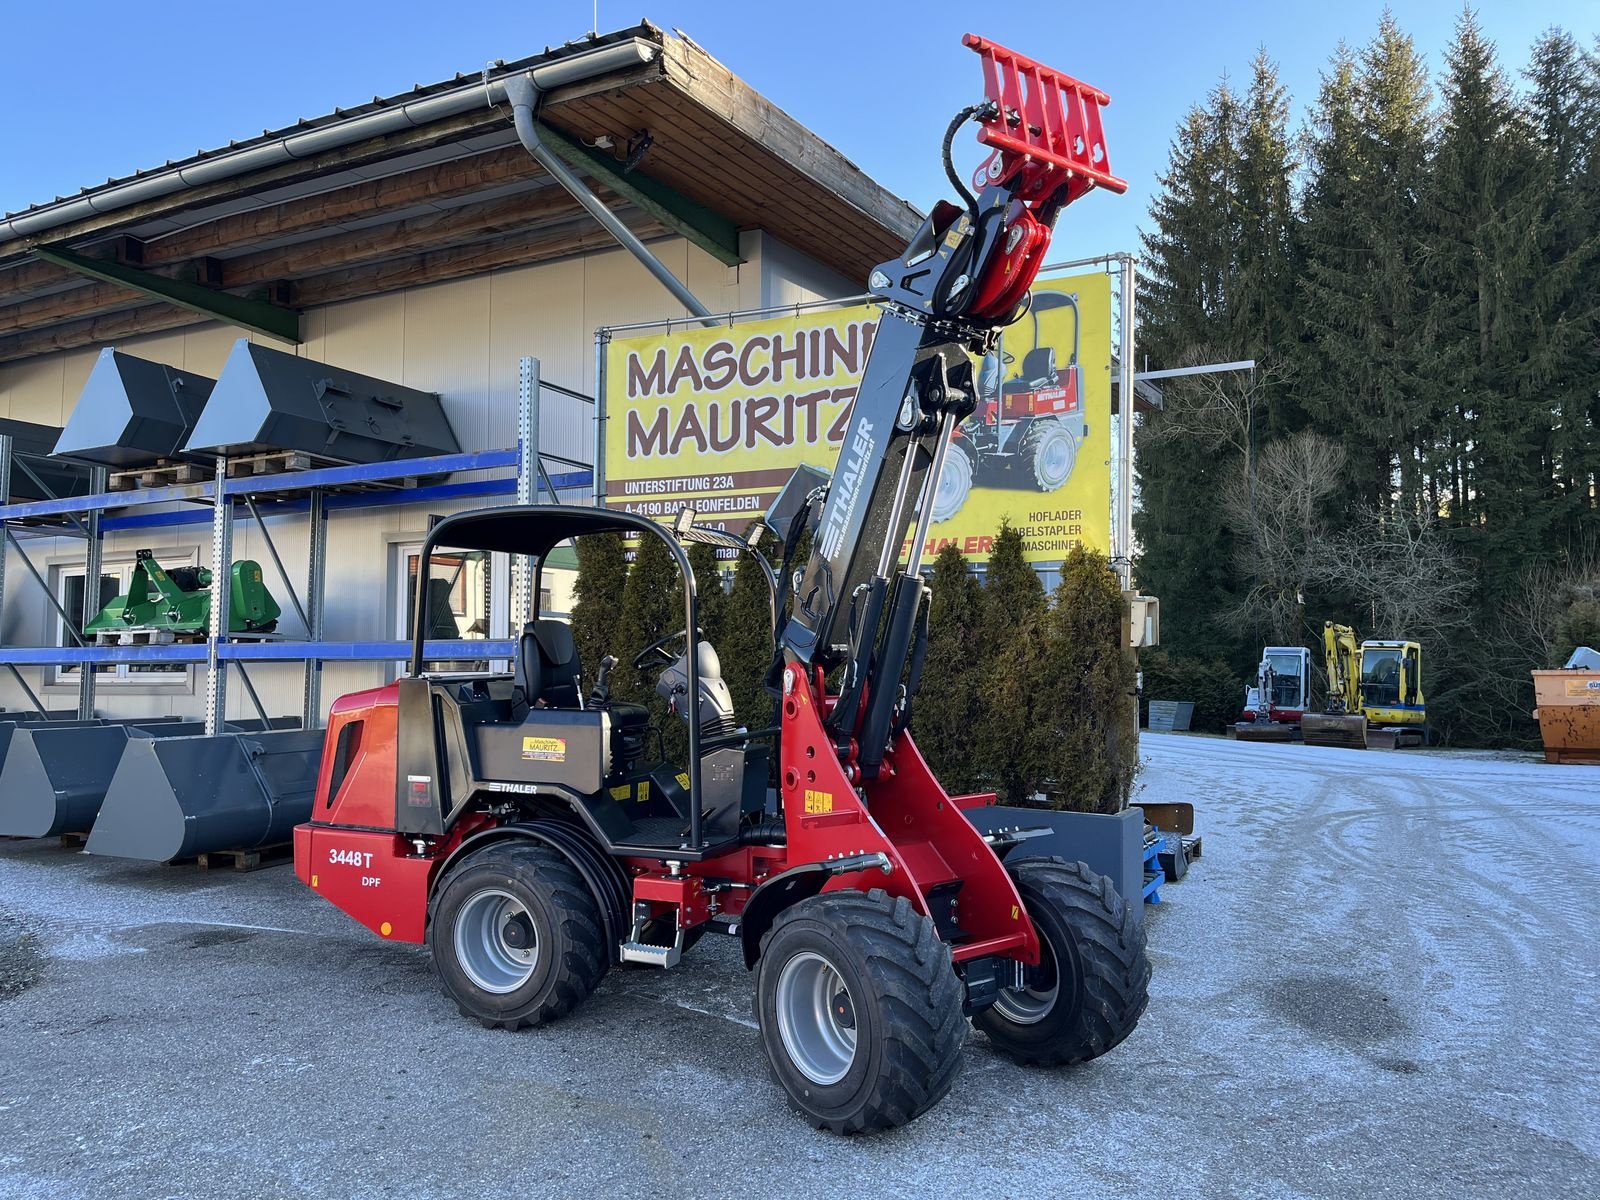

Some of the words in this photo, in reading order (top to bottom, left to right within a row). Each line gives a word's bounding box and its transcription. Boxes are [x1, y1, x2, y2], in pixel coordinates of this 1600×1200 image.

[625, 478, 710, 495] UNTERSTIFTUNG
[713, 475, 735, 489] 23A
[834, 438, 876, 559] www.maschinen-mauritz.at
[625, 503, 662, 515] A-4190
[1029, 510, 1082, 522] HOFLADER
[361, 876, 381, 887] DPF
